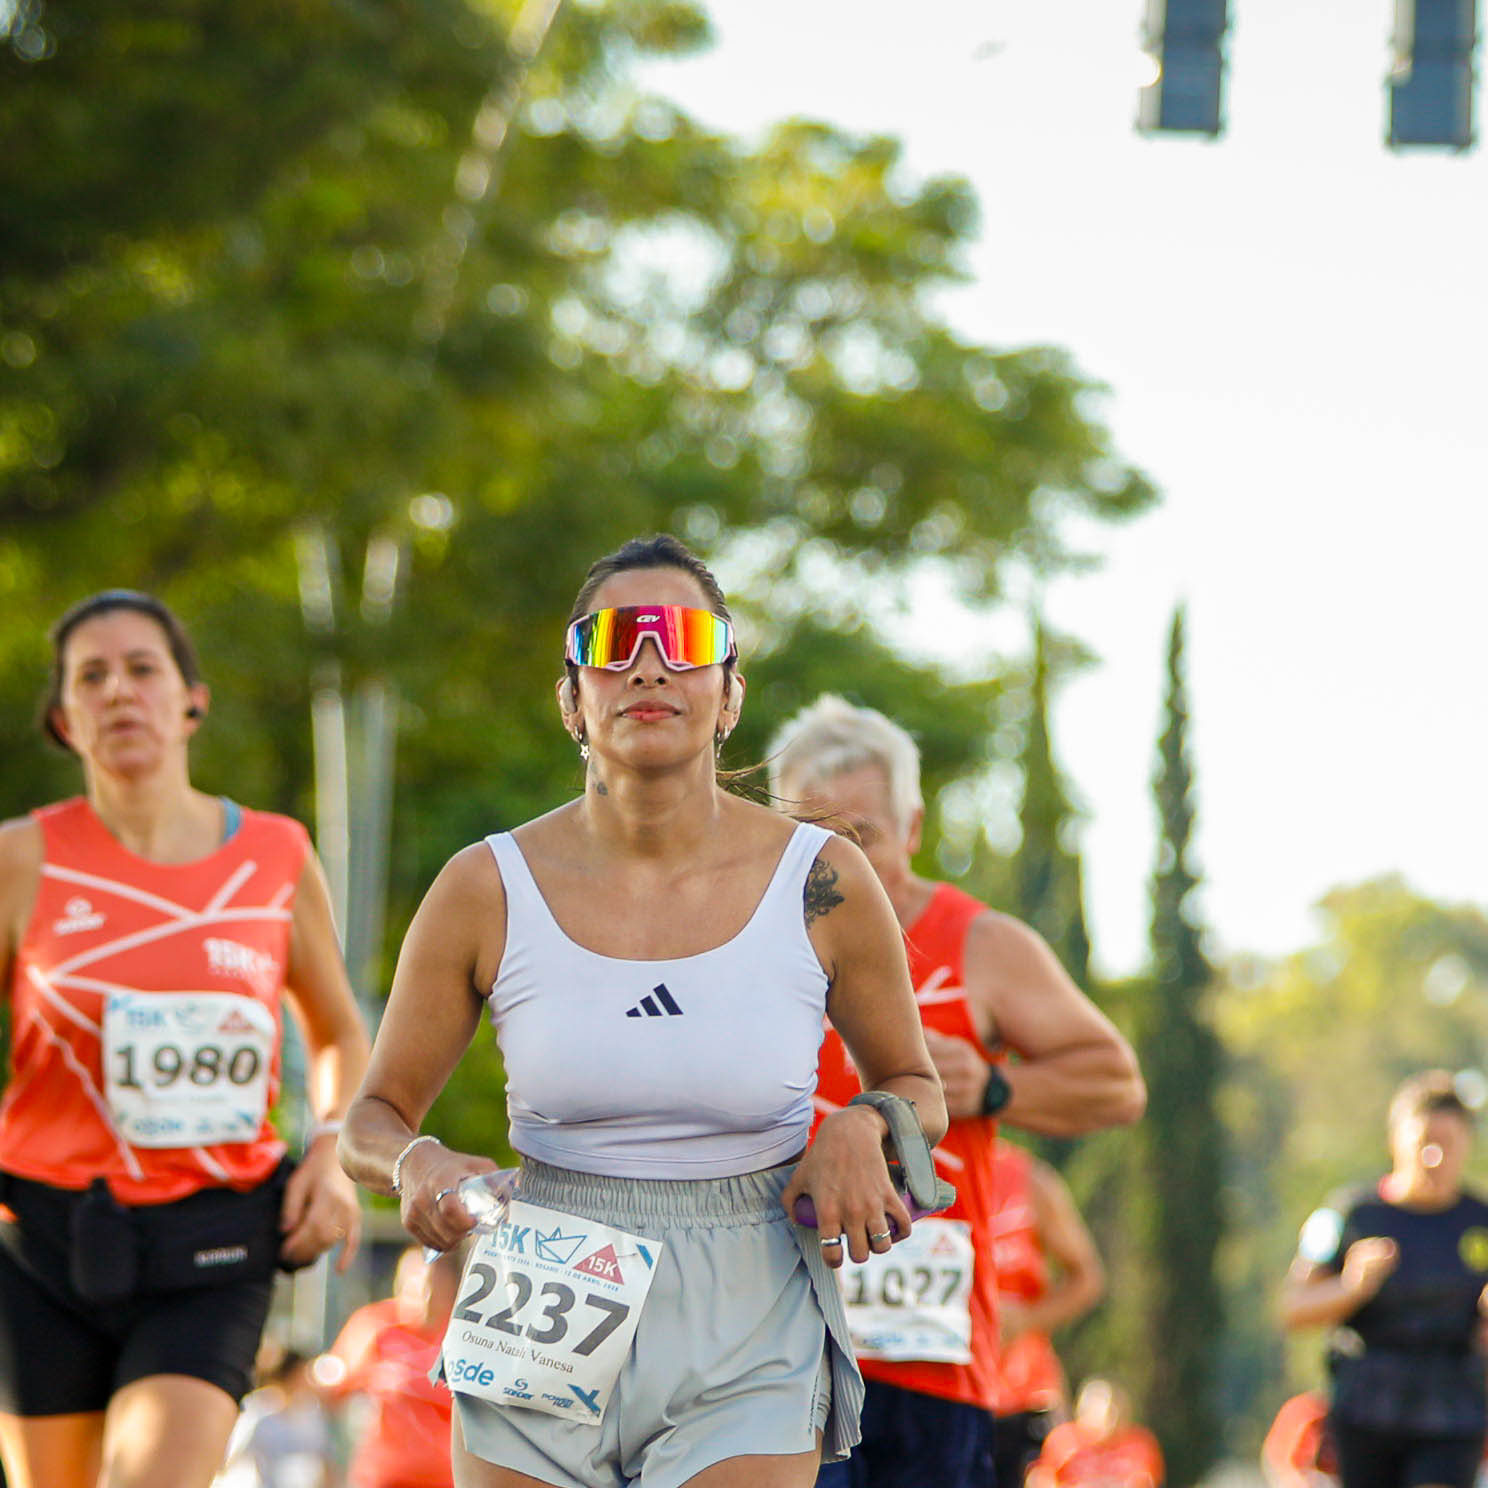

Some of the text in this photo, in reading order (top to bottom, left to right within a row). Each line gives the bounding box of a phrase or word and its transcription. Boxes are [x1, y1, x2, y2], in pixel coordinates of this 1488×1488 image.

[116, 1046, 259, 1089] 1980
[491, 1223, 531, 1254] 15K
[588, 1256, 618, 1277] 15K
[847, 1266, 962, 1307] 1027
[453, 1262, 630, 1357] 2237
[462, 1330, 494, 1349] Osuna
[531, 1349, 574, 1373] Vanesa
